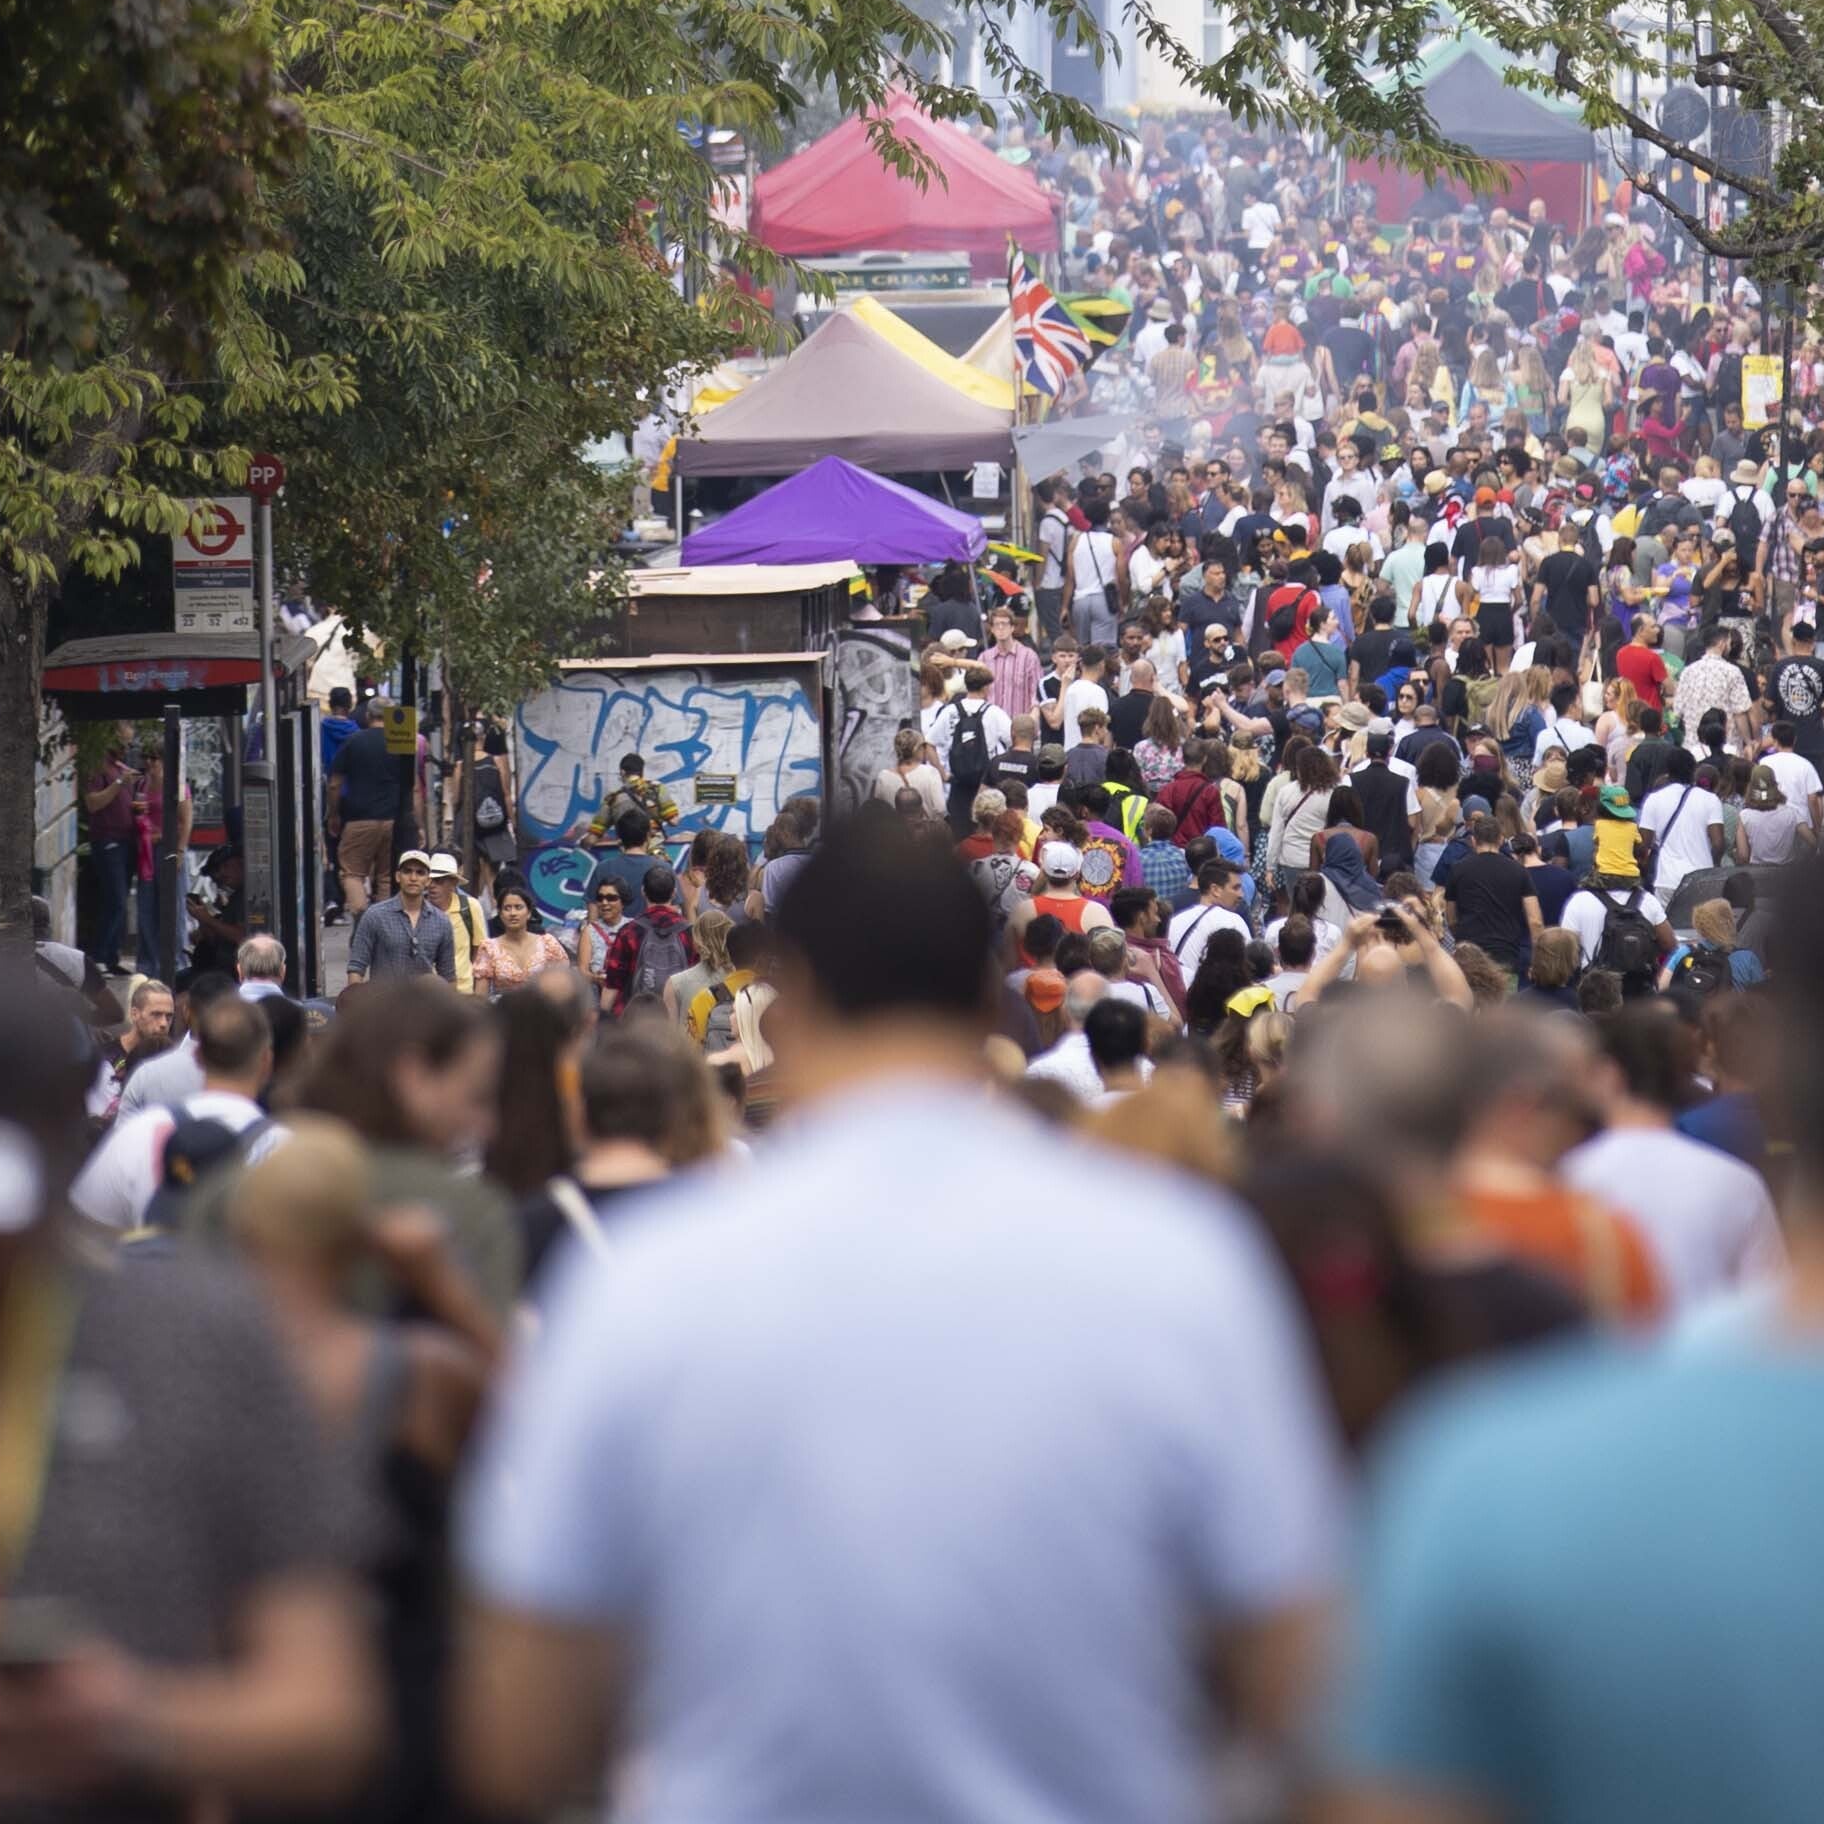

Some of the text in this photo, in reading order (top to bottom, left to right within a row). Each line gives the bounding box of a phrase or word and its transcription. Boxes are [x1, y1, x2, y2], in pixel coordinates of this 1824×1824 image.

[871, 273, 950, 285] CREAM
[249, 466, 277, 485] PP
[233, 617, 249, 625] 452
